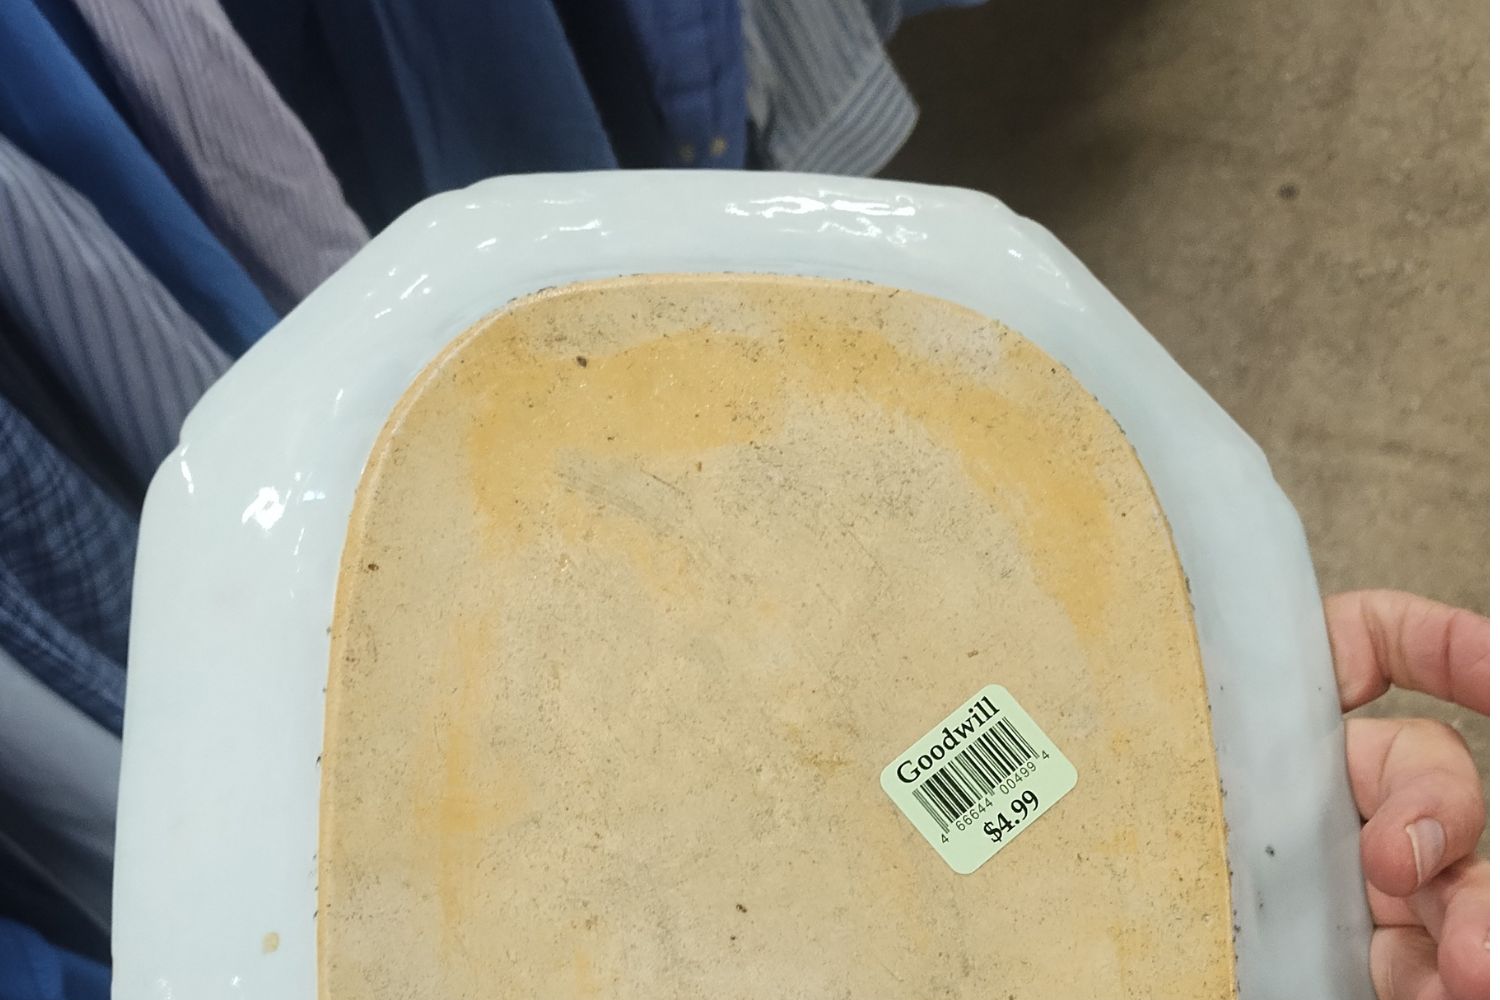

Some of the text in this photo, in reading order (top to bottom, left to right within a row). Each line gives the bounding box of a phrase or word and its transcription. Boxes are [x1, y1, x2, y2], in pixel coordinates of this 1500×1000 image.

[896, 696, 1000, 784] Goodwill
[955, 797, 993, 831] 66644
[999, 761, 1037, 795] 00499
[982, 789, 1039, 843] $4.99
